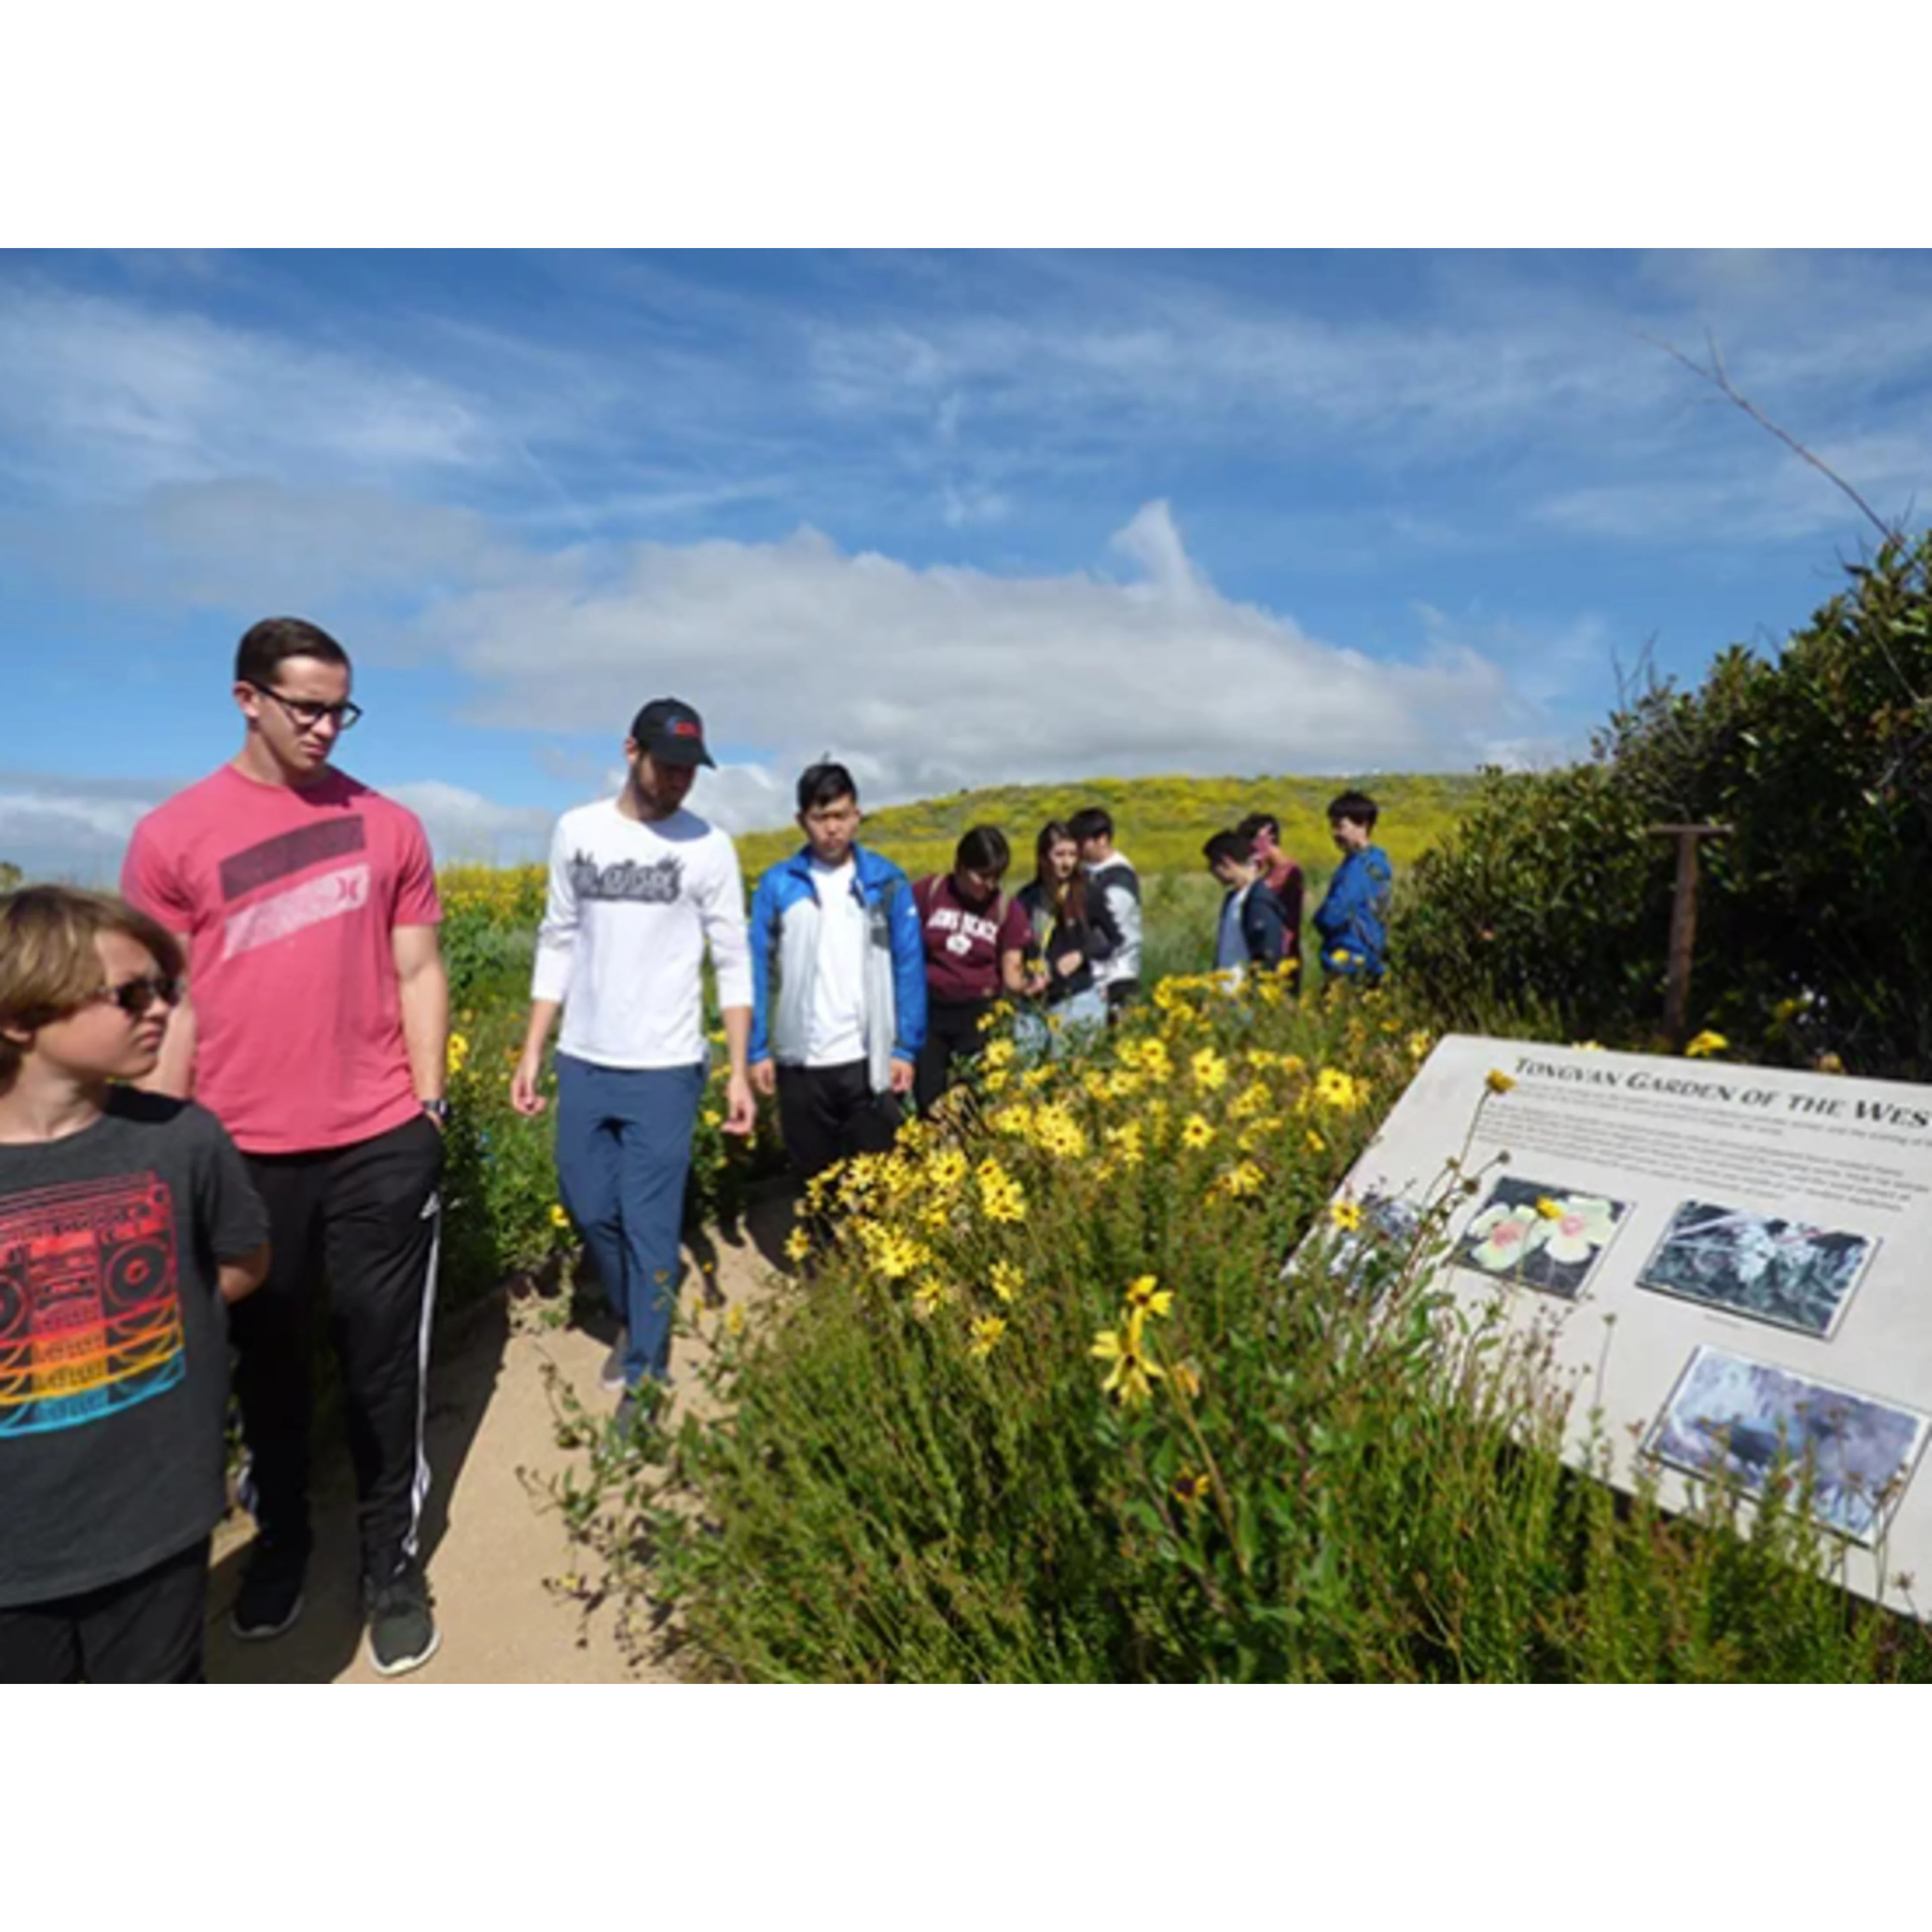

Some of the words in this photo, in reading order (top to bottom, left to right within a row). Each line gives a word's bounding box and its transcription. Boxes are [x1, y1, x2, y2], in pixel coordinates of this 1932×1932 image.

[1514, 1057, 1624, 1086] TONGVAN
[1626, 1071, 1738, 1102] GARDEN
[1740, 1087, 1781, 1107] OF
[1787, 1093, 1846, 1117] THE
[1855, 1099, 1930, 1128] WES
